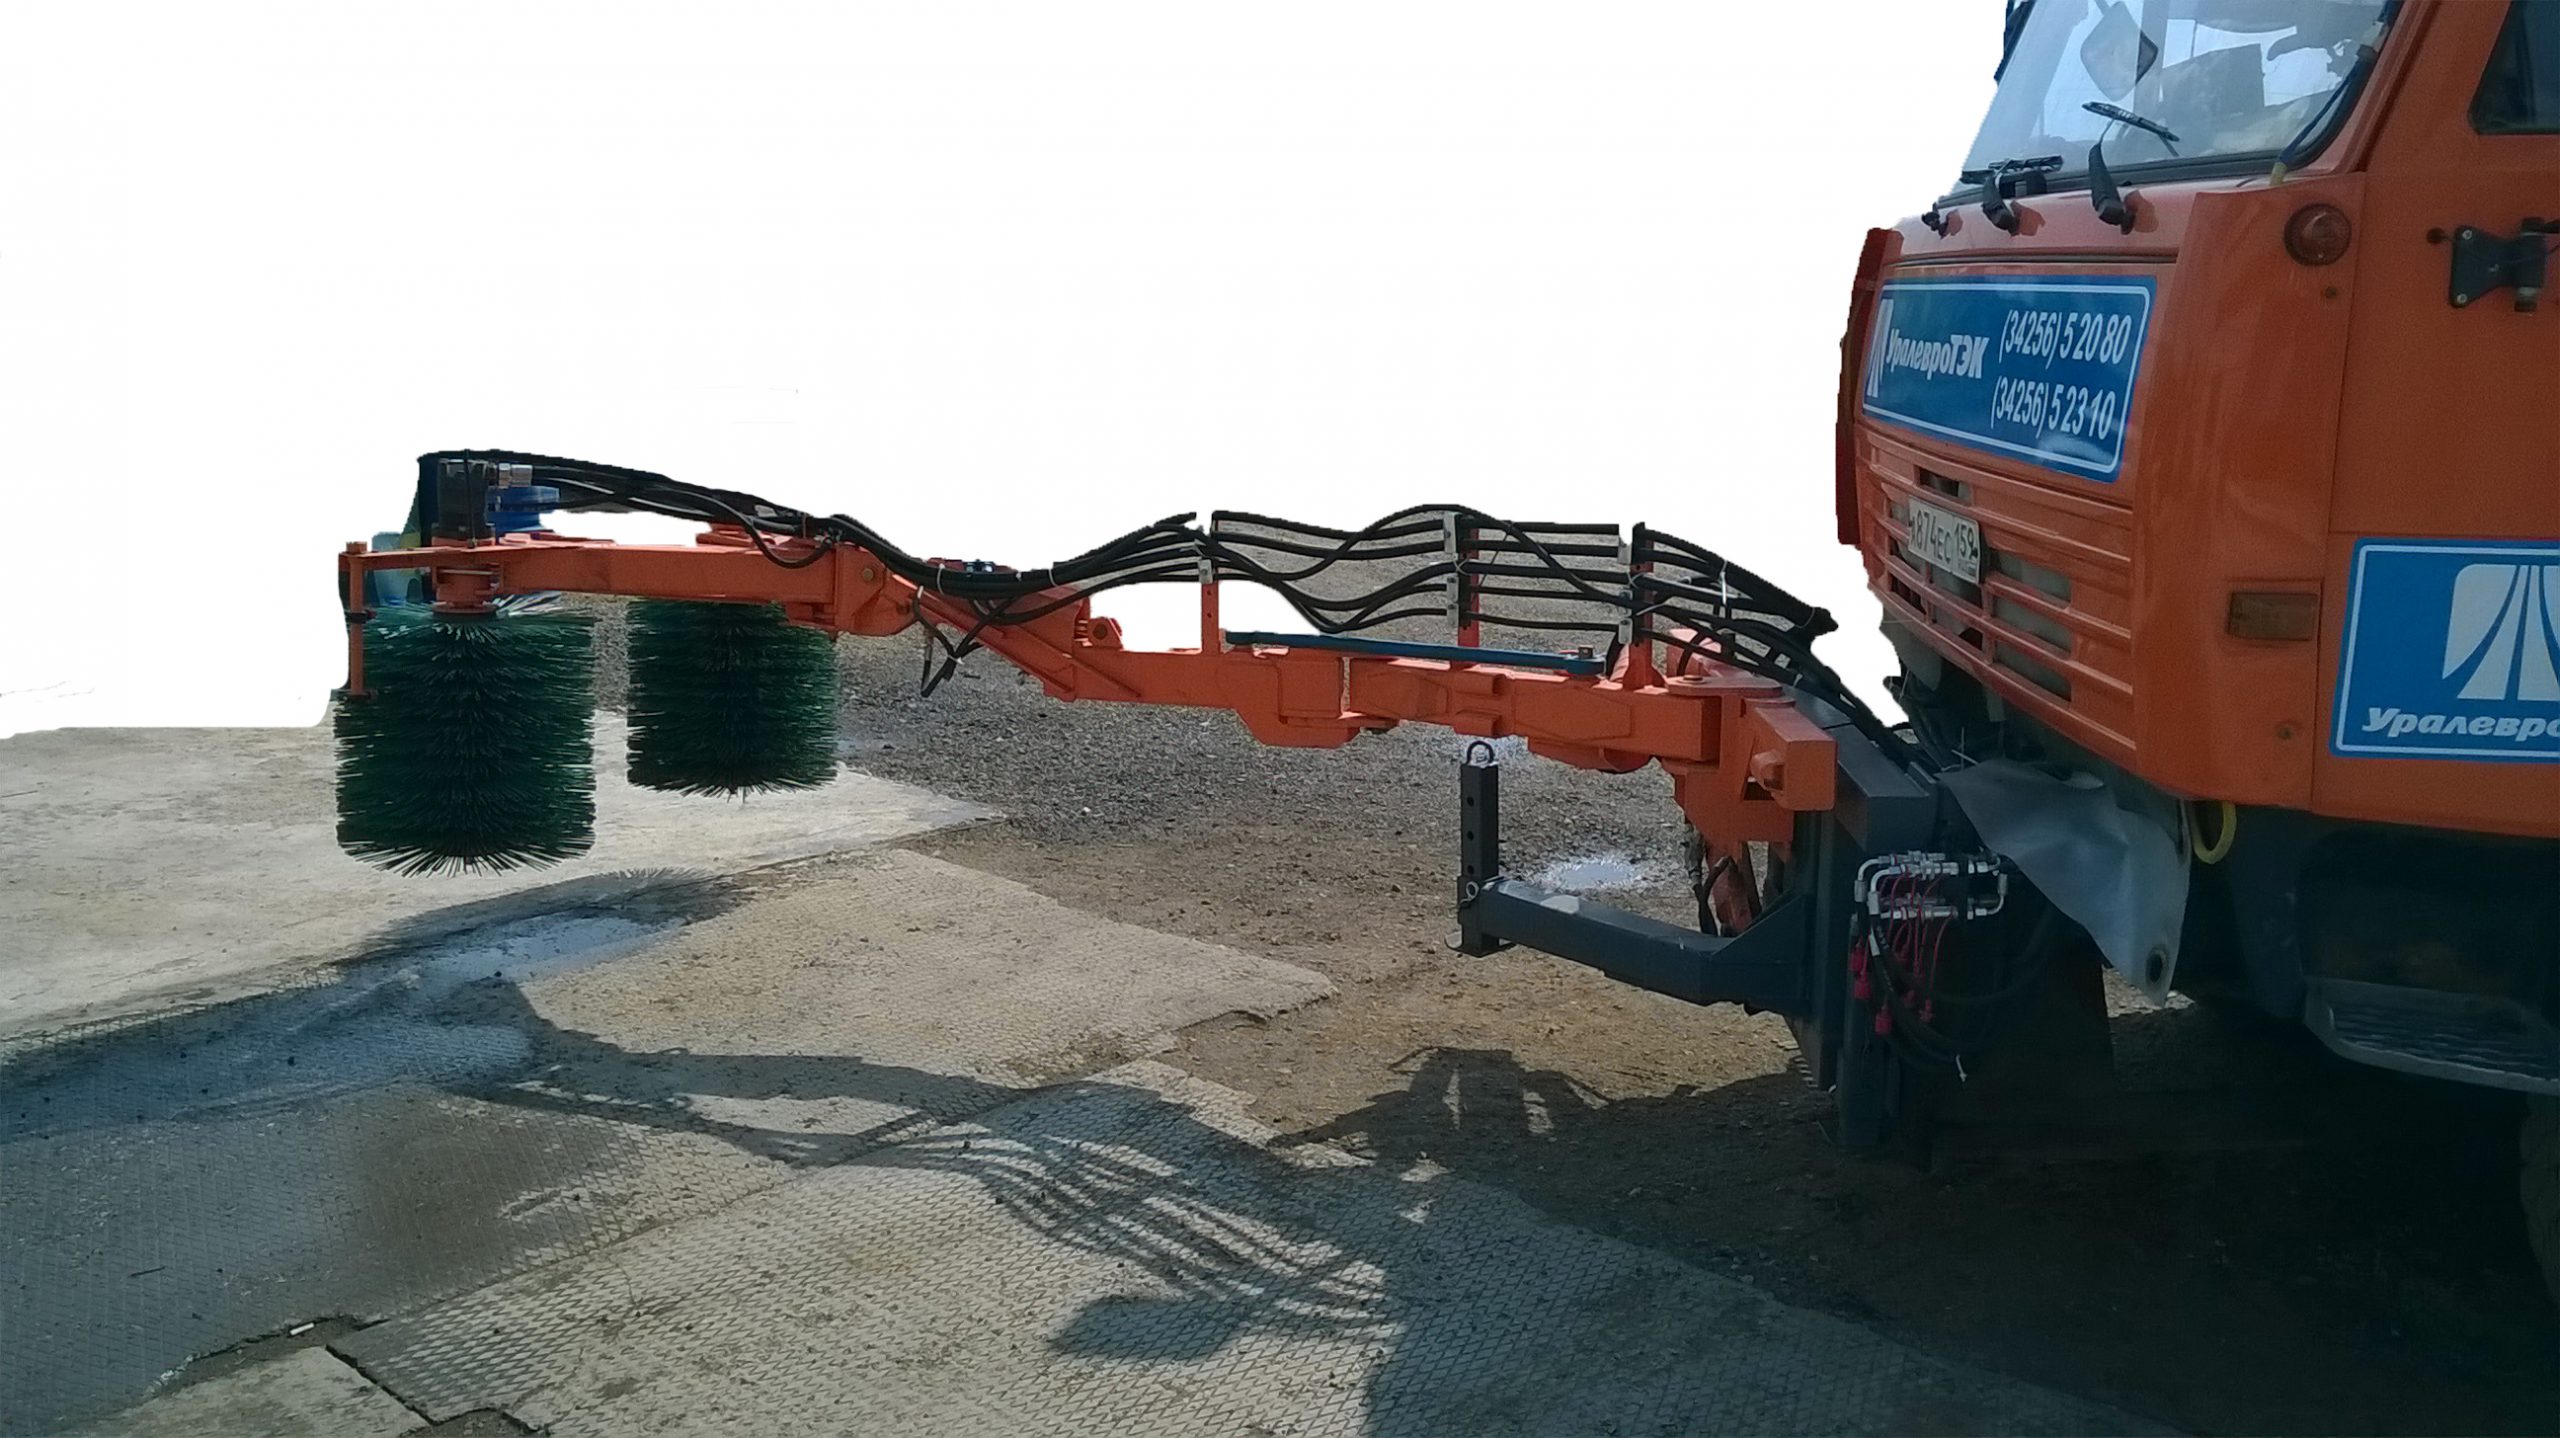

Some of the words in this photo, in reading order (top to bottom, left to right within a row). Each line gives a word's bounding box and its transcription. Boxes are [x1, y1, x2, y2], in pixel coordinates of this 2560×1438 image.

[1886, 328, 1990, 380] УралевроТЭК
[1999, 309, 2062, 369] (34256)
[2060, 312, 2078, 359] 5
[2072, 312, 2103, 361] 20
[2100, 314, 2132, 364] 80
[1990, 375, 2050, 439] (34256)
[2049, 384, 2064, 430] 5
[2060, 385, 2088, 435] 23
[2088, 389, 2116, 440] 10
